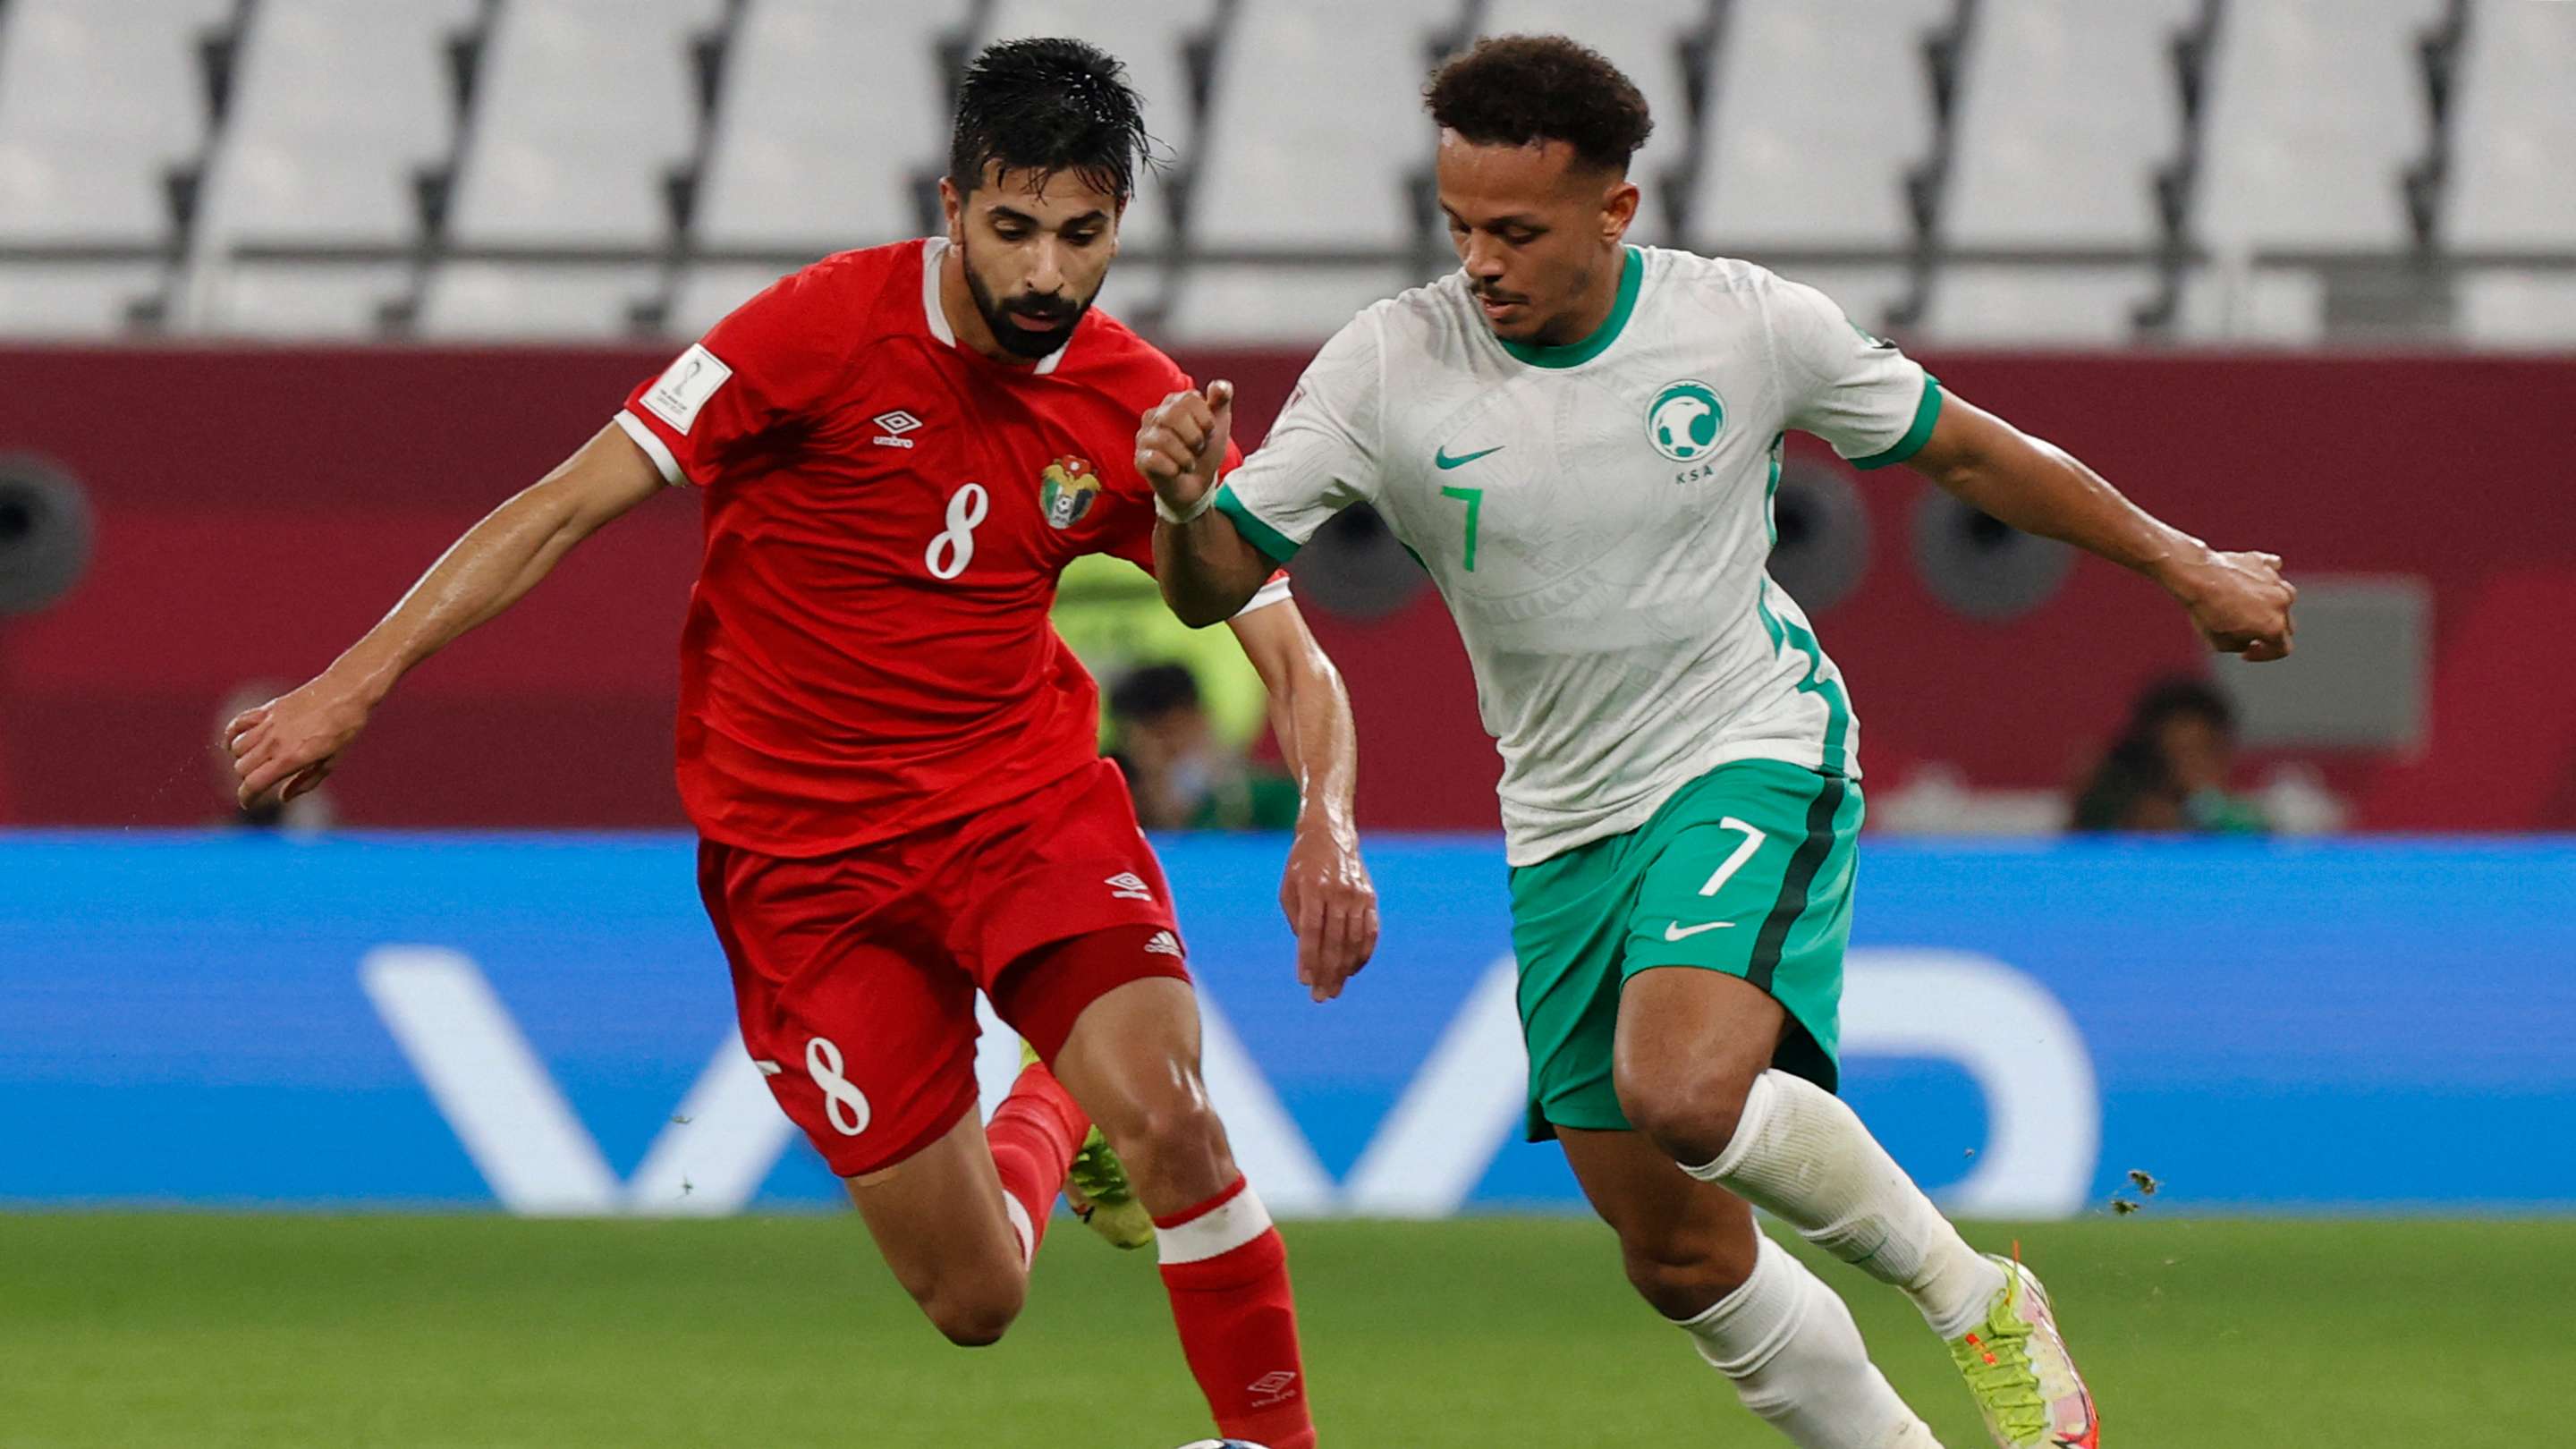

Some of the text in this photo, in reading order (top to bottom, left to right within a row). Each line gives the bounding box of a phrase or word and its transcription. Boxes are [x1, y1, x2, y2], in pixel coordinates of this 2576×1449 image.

[1675, 464, 1714, 484] KSA
[925, 483, 988, 580] 8
[1441, 485, 1483, 572] 7
[1698, 816, 1767, 896] 7
[806, 1037, 871, 1136] 8
